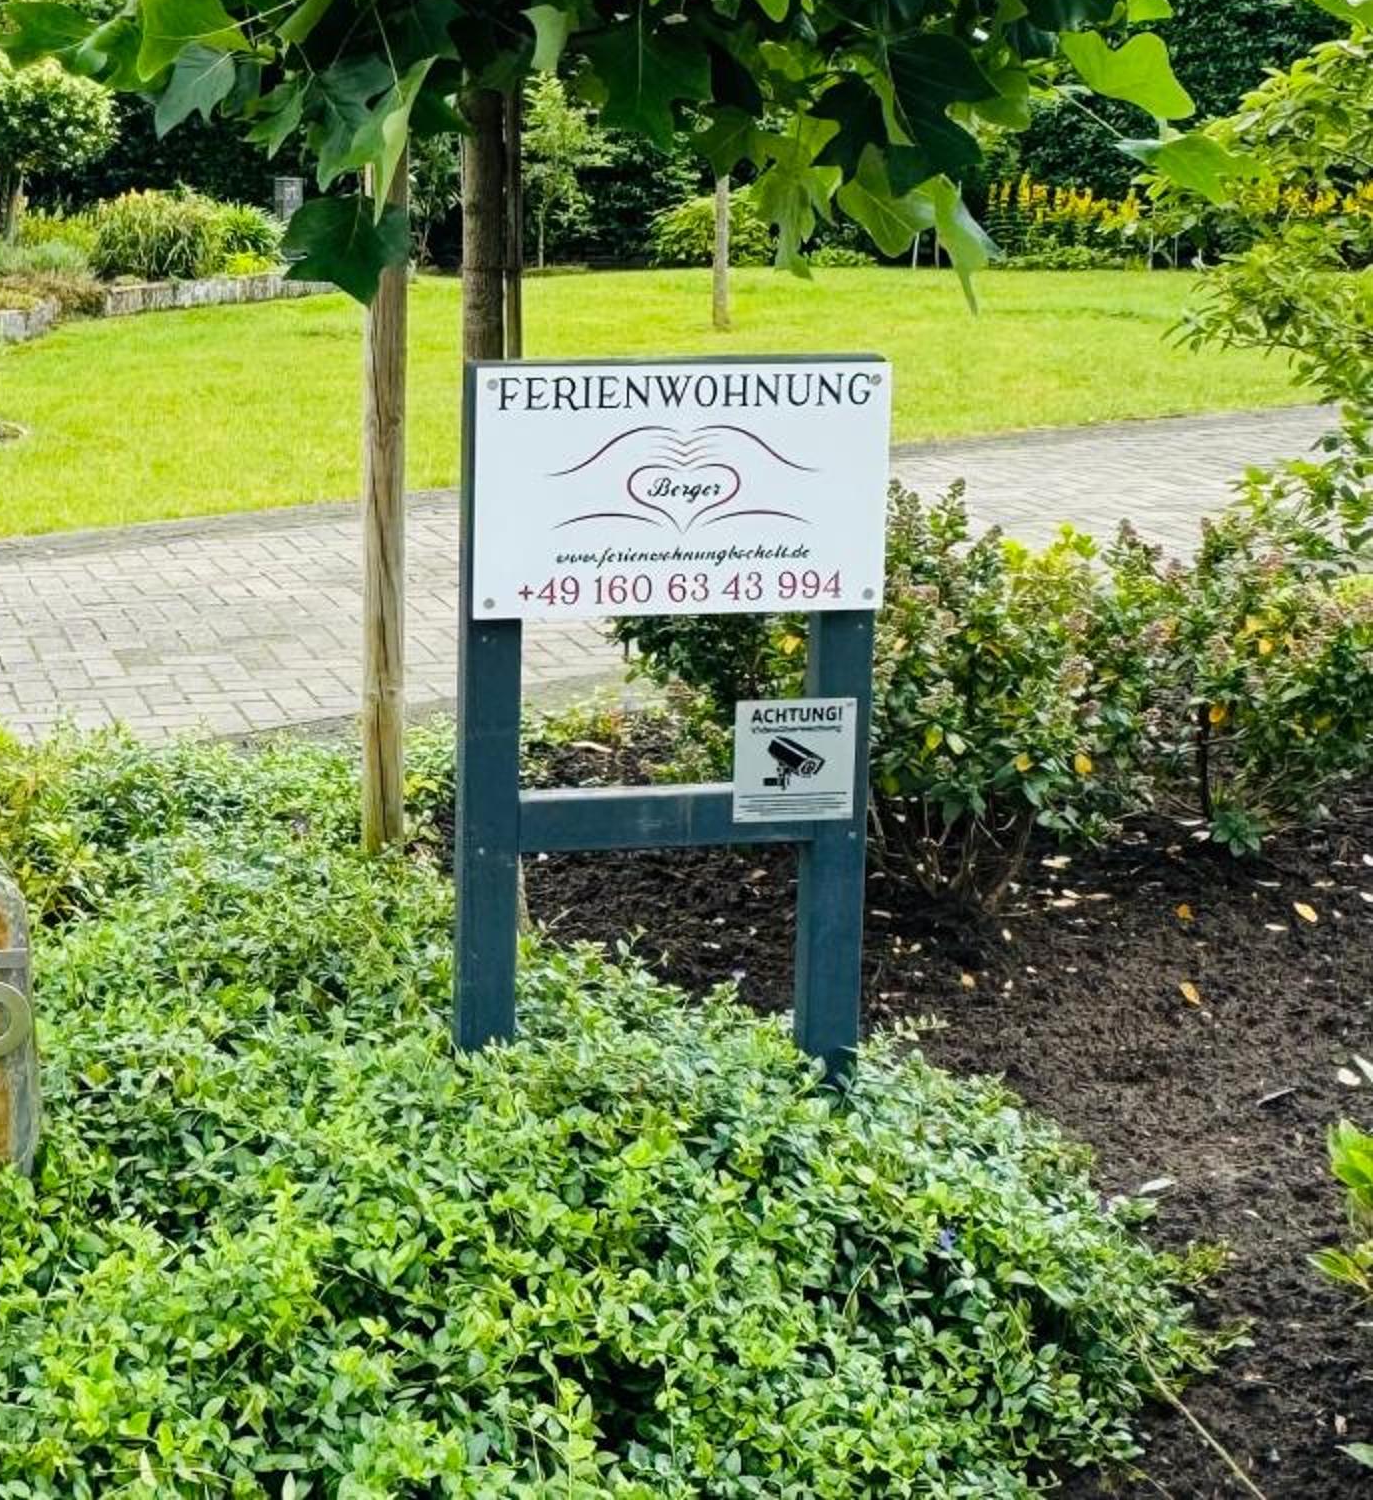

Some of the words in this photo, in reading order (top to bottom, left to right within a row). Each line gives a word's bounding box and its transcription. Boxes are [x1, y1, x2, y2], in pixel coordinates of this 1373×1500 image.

[498, 373, 871, 411] FERIENWOHNUNG
[647, 477, 723, 502] Berger
[518, 576, 580, 606] +49
[594, 574, 653, 604] 160
[668, 573, 710, 603] 63
[722, 571, 763, 601] 43
[777, 569, 842, 599] 994
[752, 706, 843, 724] ACHTUNG!
